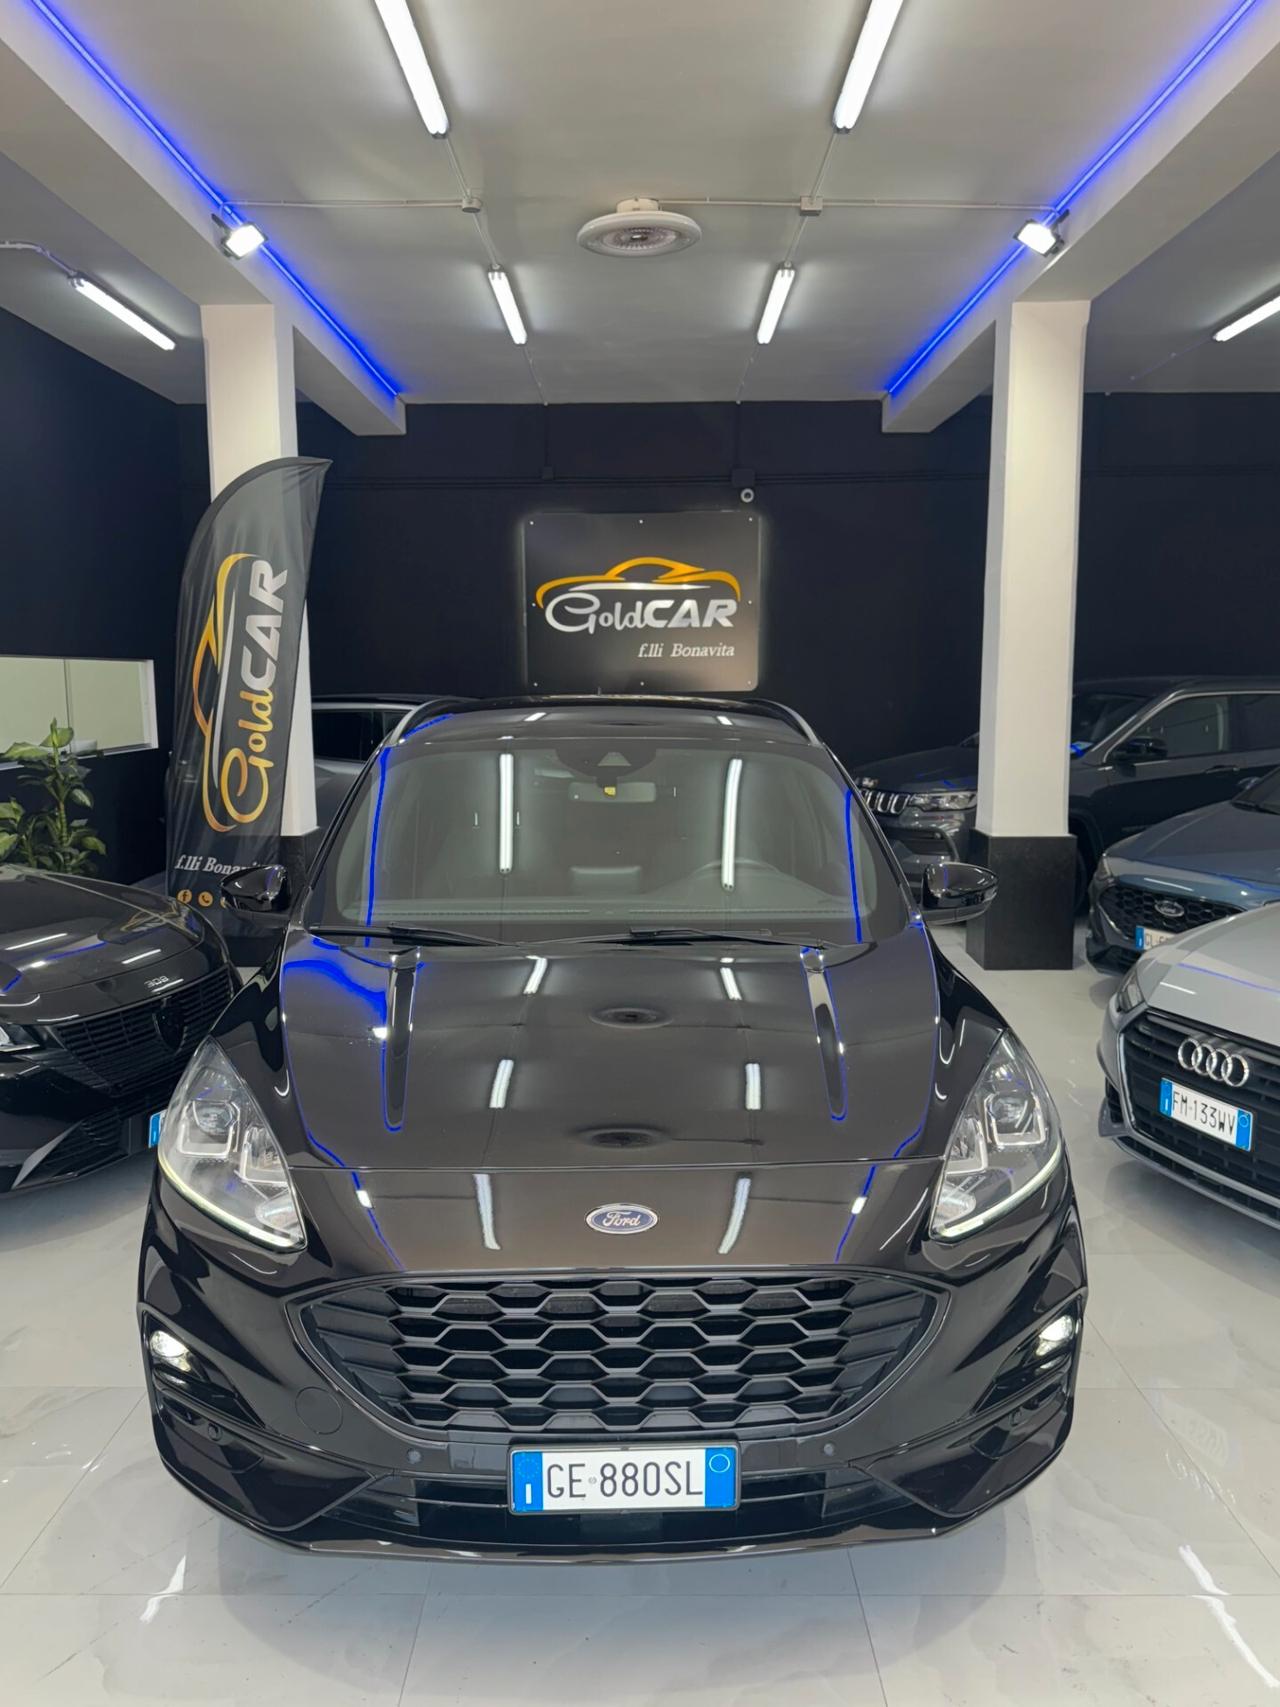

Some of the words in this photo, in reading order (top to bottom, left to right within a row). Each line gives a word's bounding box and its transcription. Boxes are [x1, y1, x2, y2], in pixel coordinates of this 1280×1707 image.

[545, 592, 738, 635] GoldCAR
[638, 642, 663, 658] f.lli
[670, 642, 735, 658] Bonavita
[220, 559, 288, 824] GoldCAR
[174, 854, 203, 871] f.lli
[1173, 1090, 1188, 1118] FM
[1193, 1099, 1236, 1137] 133WV
[602, 1211, 641, 1227] Ford
[546, 1463, 587, 1499] GE
[599, 1461, 703, 1498] 880SL
